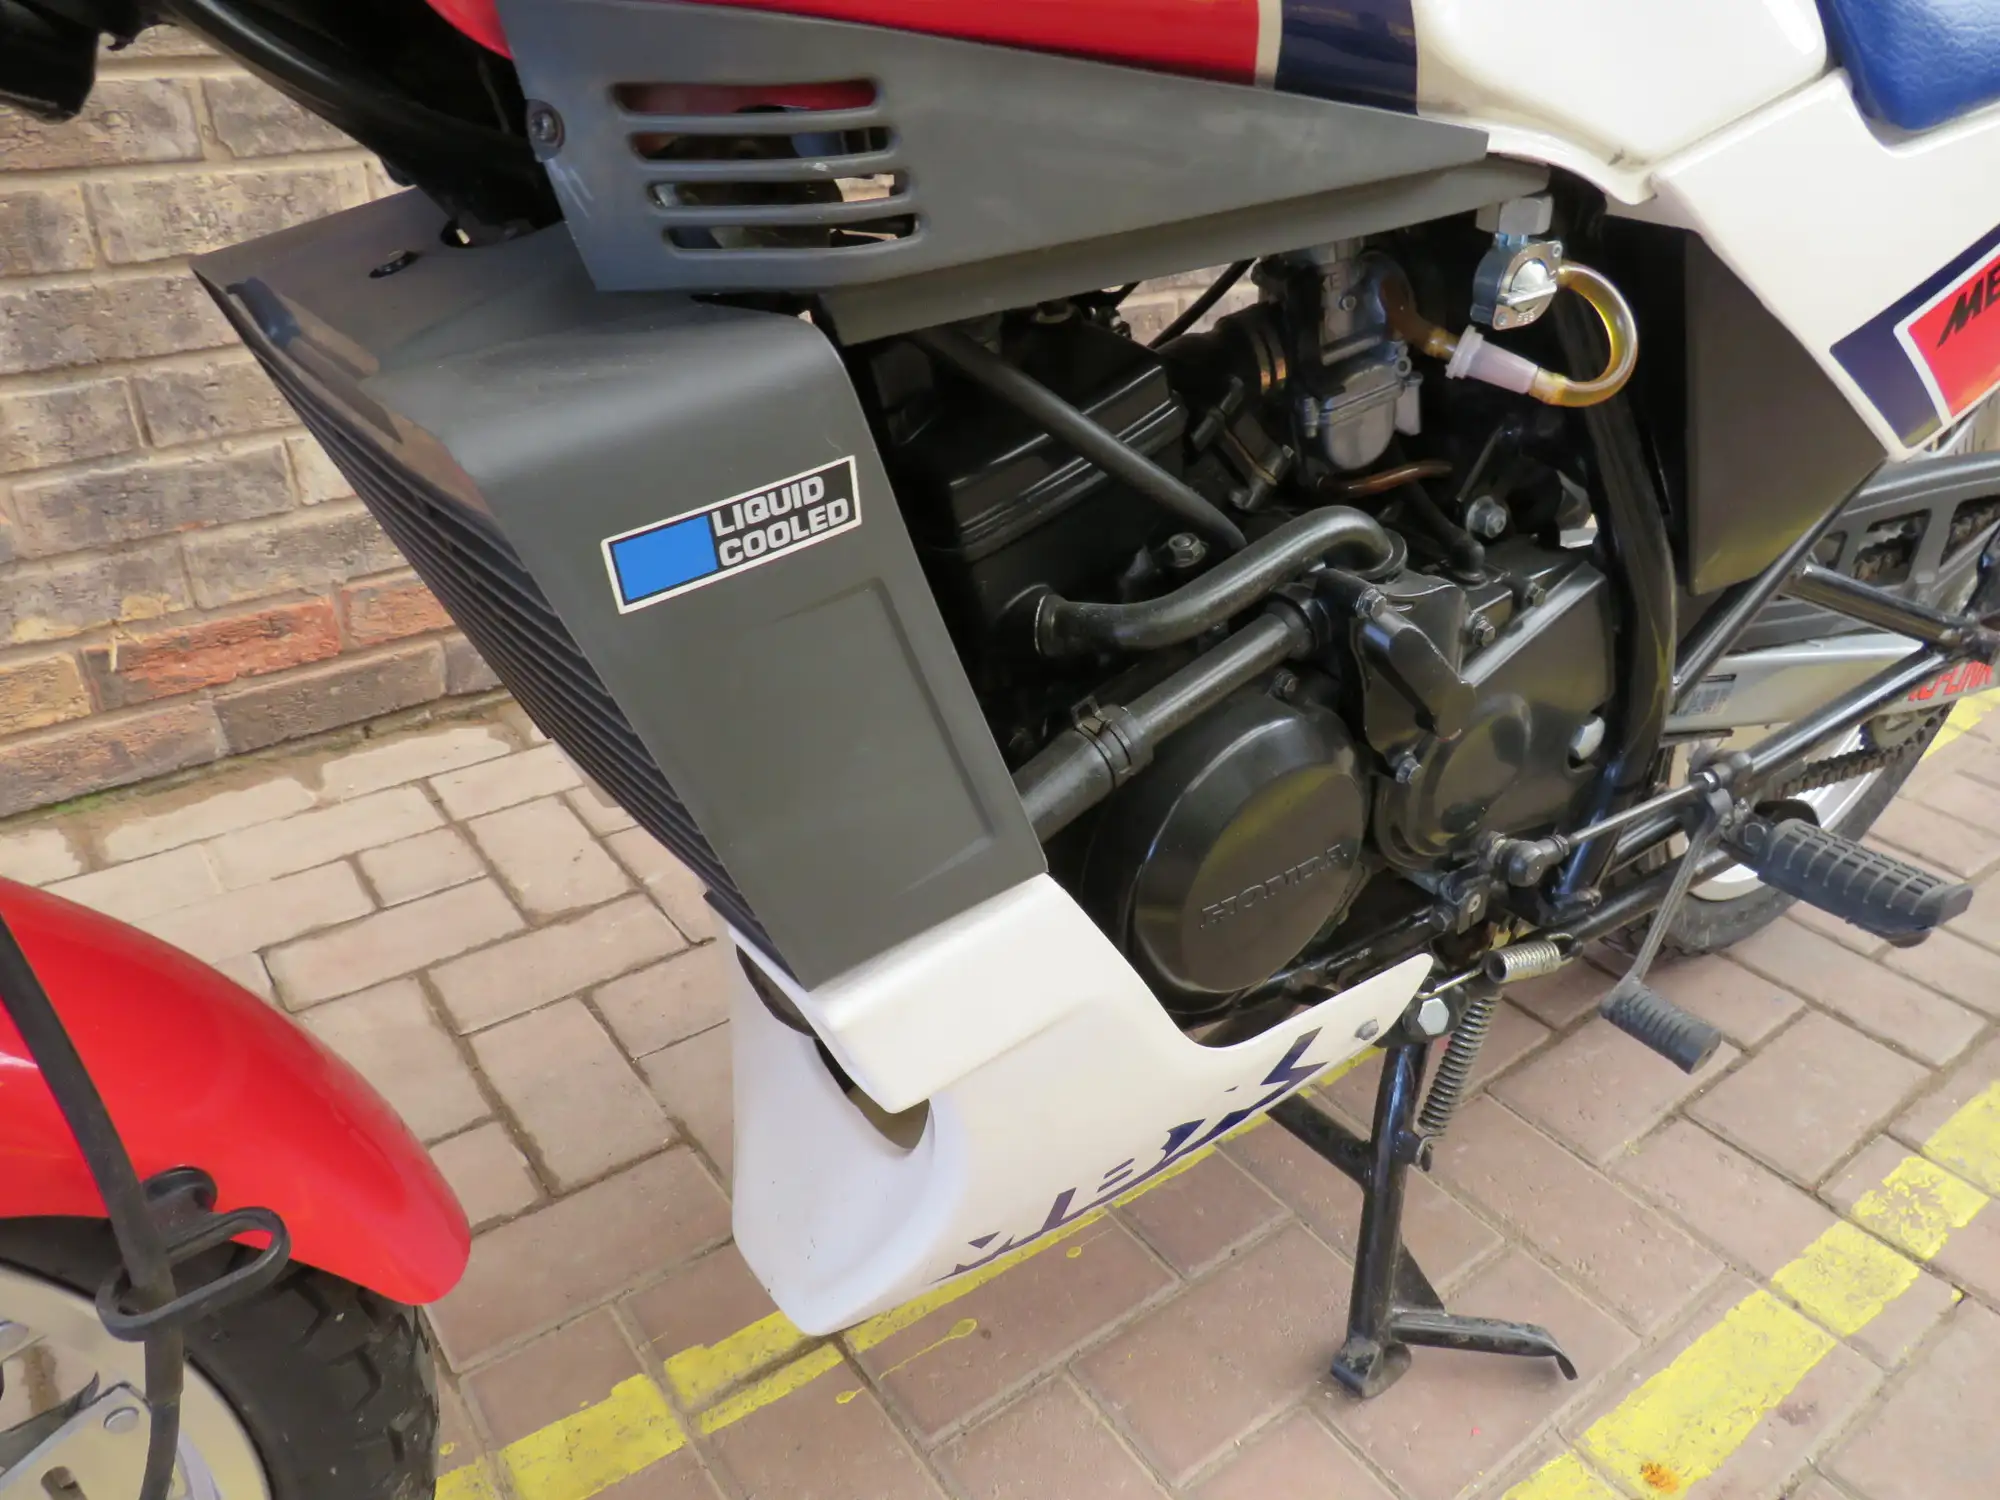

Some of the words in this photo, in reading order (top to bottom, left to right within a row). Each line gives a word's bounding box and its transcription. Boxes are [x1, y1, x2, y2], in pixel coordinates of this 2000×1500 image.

[711, 476, 825, 537] LIQUID
[718, 498, 849, 567] COOLED
[1199, 842, 1348, 930] HONDA
